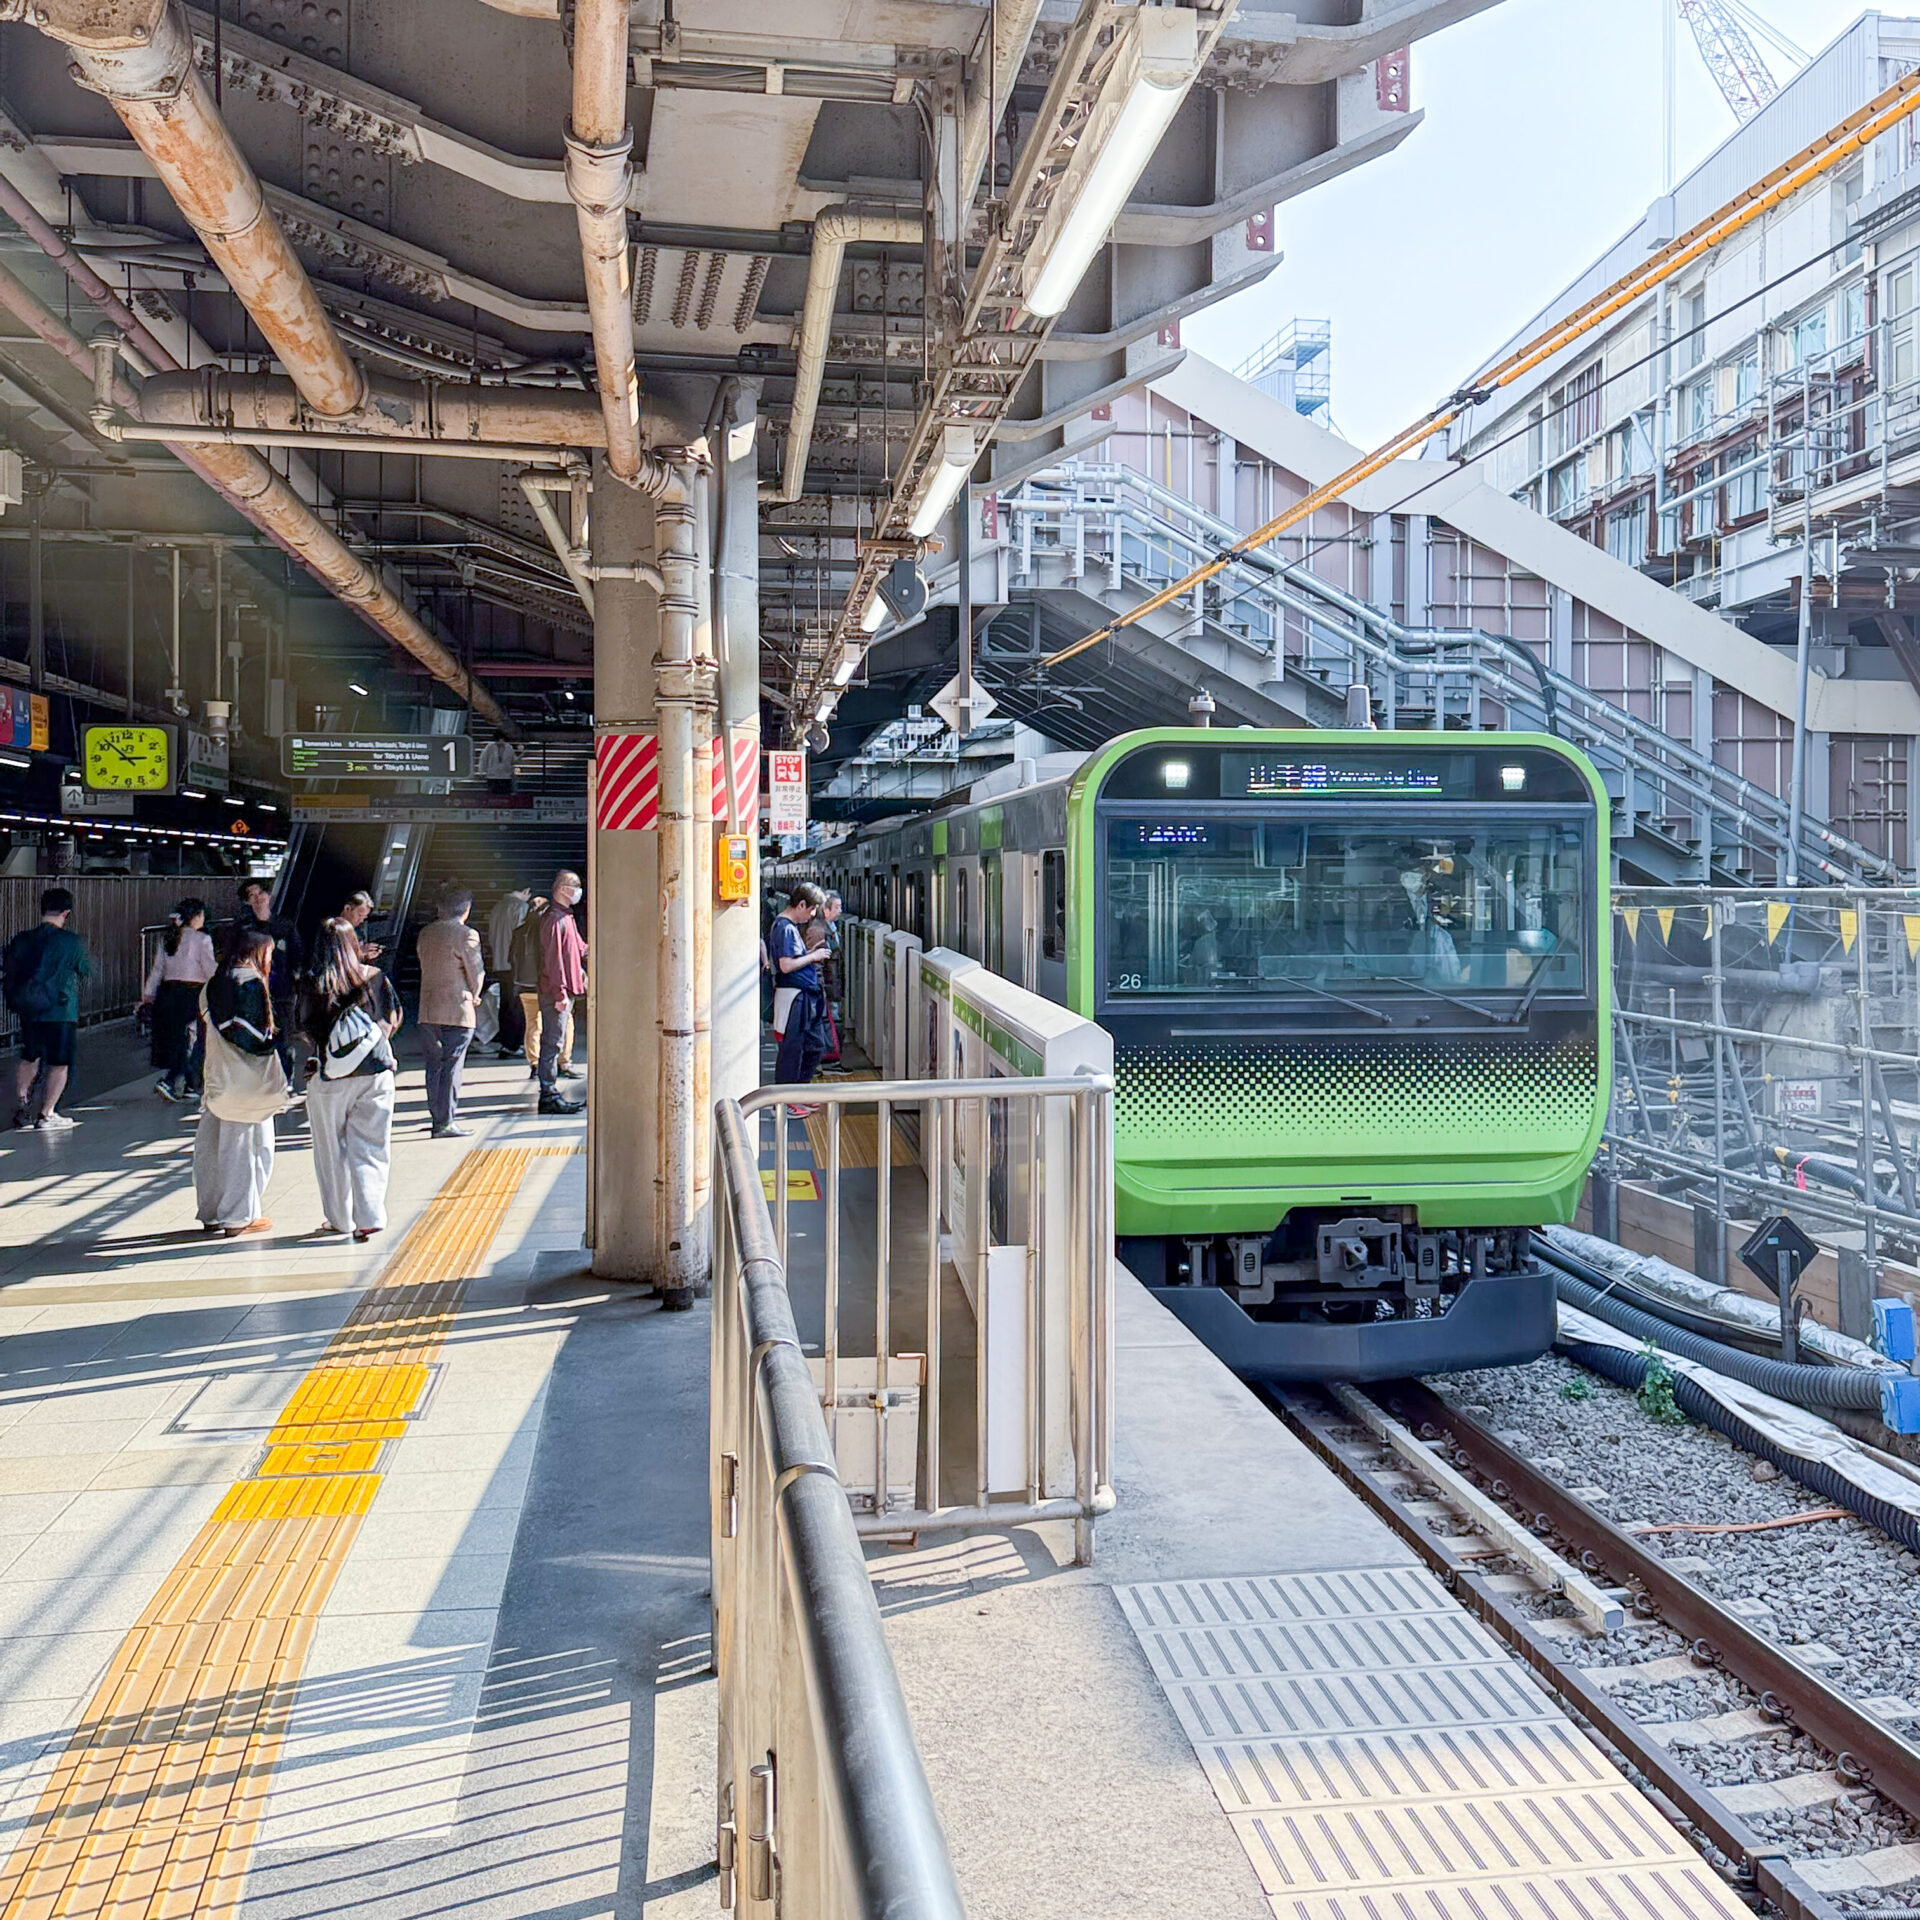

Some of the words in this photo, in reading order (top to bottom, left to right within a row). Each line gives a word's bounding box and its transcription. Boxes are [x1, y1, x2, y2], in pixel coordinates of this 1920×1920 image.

[111, 734, 120, 743] 11
[122, 731, 133, 740] 12
[139, 734, 144, 743] 1
[99, 743, 110, 752] 10
[149, 742, 157, 750] 2
[94, 754, 102, 763] 9
[154, 755, 162, 763] 3
[442, 742, 456, 772] 1
[776, 756, 801, 765] STOP
[100, 767, 107, 775] 8
[346, 762, 354, 772] 3
[149, 768, 156, 776] 4
[125, 778, 132, 786] 6
[775, 784, 802, 793] 非常停止
[782, 794, 802, 802] ボタン
[1120, 974, 1142, 989] 26
